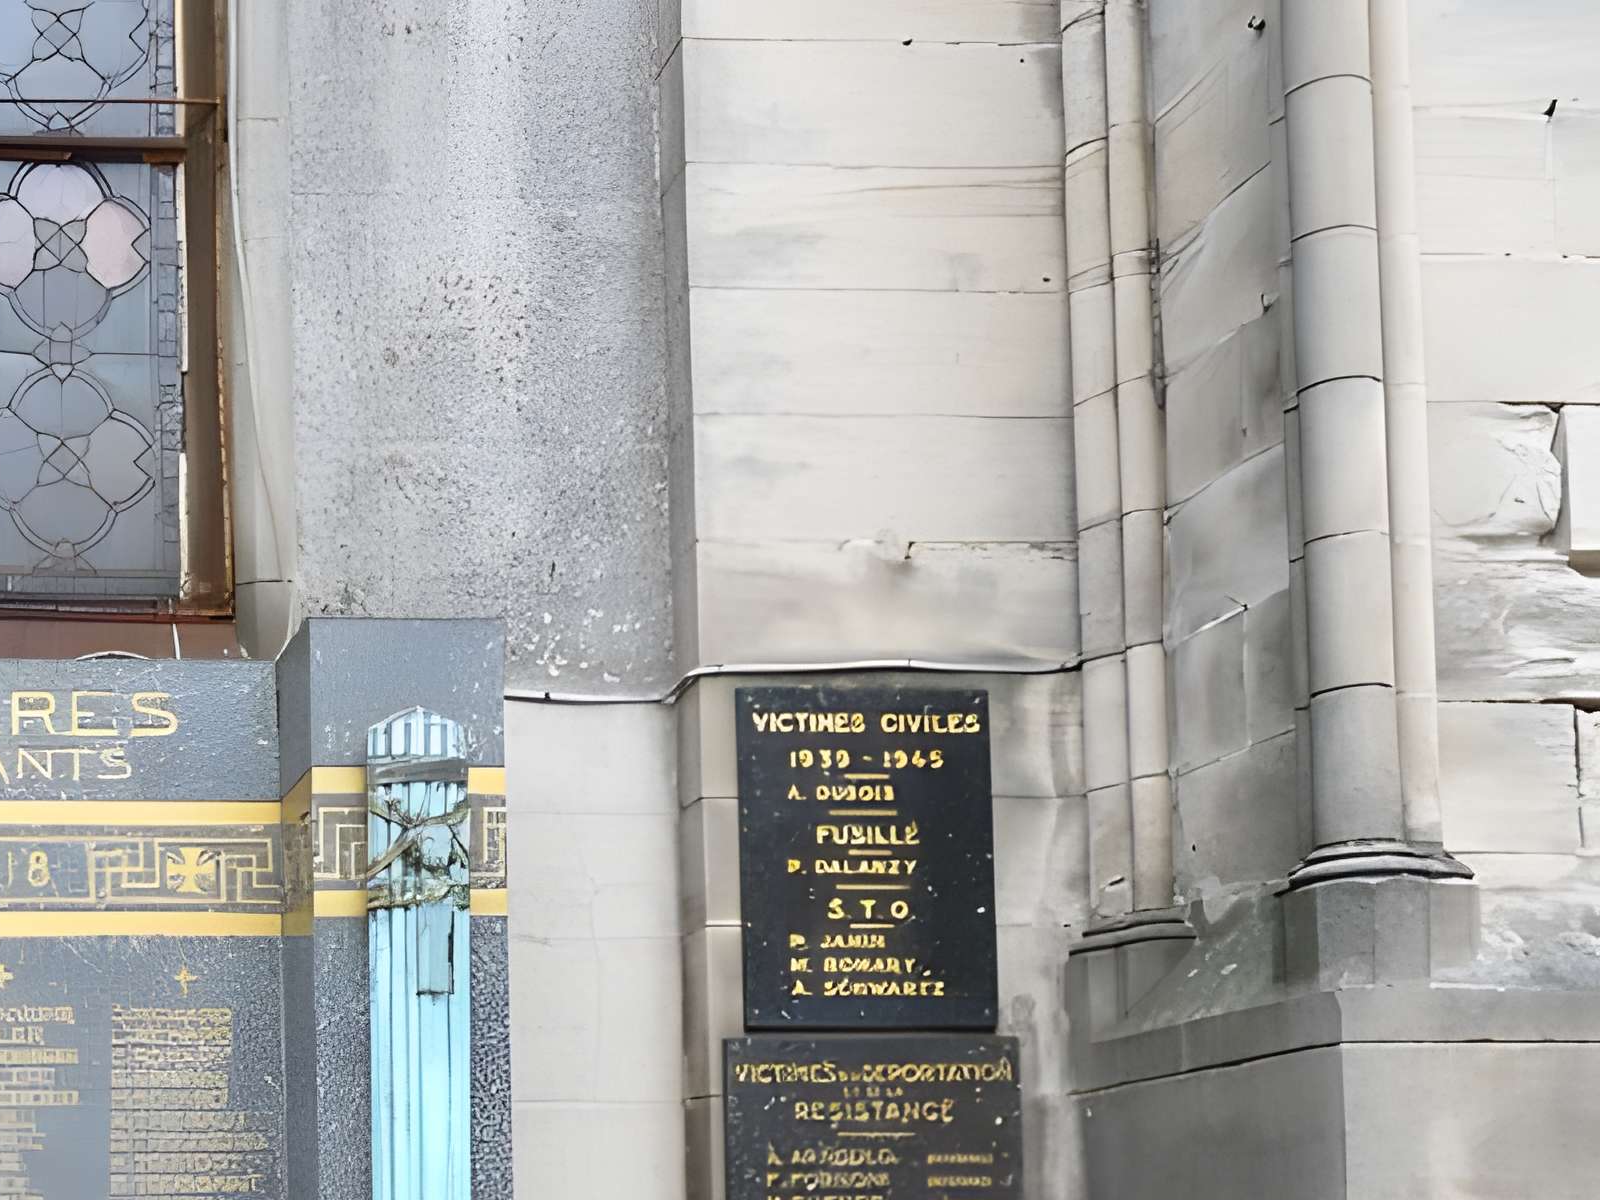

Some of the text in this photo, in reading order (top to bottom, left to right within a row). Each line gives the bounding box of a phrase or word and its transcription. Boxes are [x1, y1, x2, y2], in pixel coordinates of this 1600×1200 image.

[880, 712, 981, 733] CIVILES
[789, 749, 850, 768] 1939
[883, 749, 944, 768] 1945
